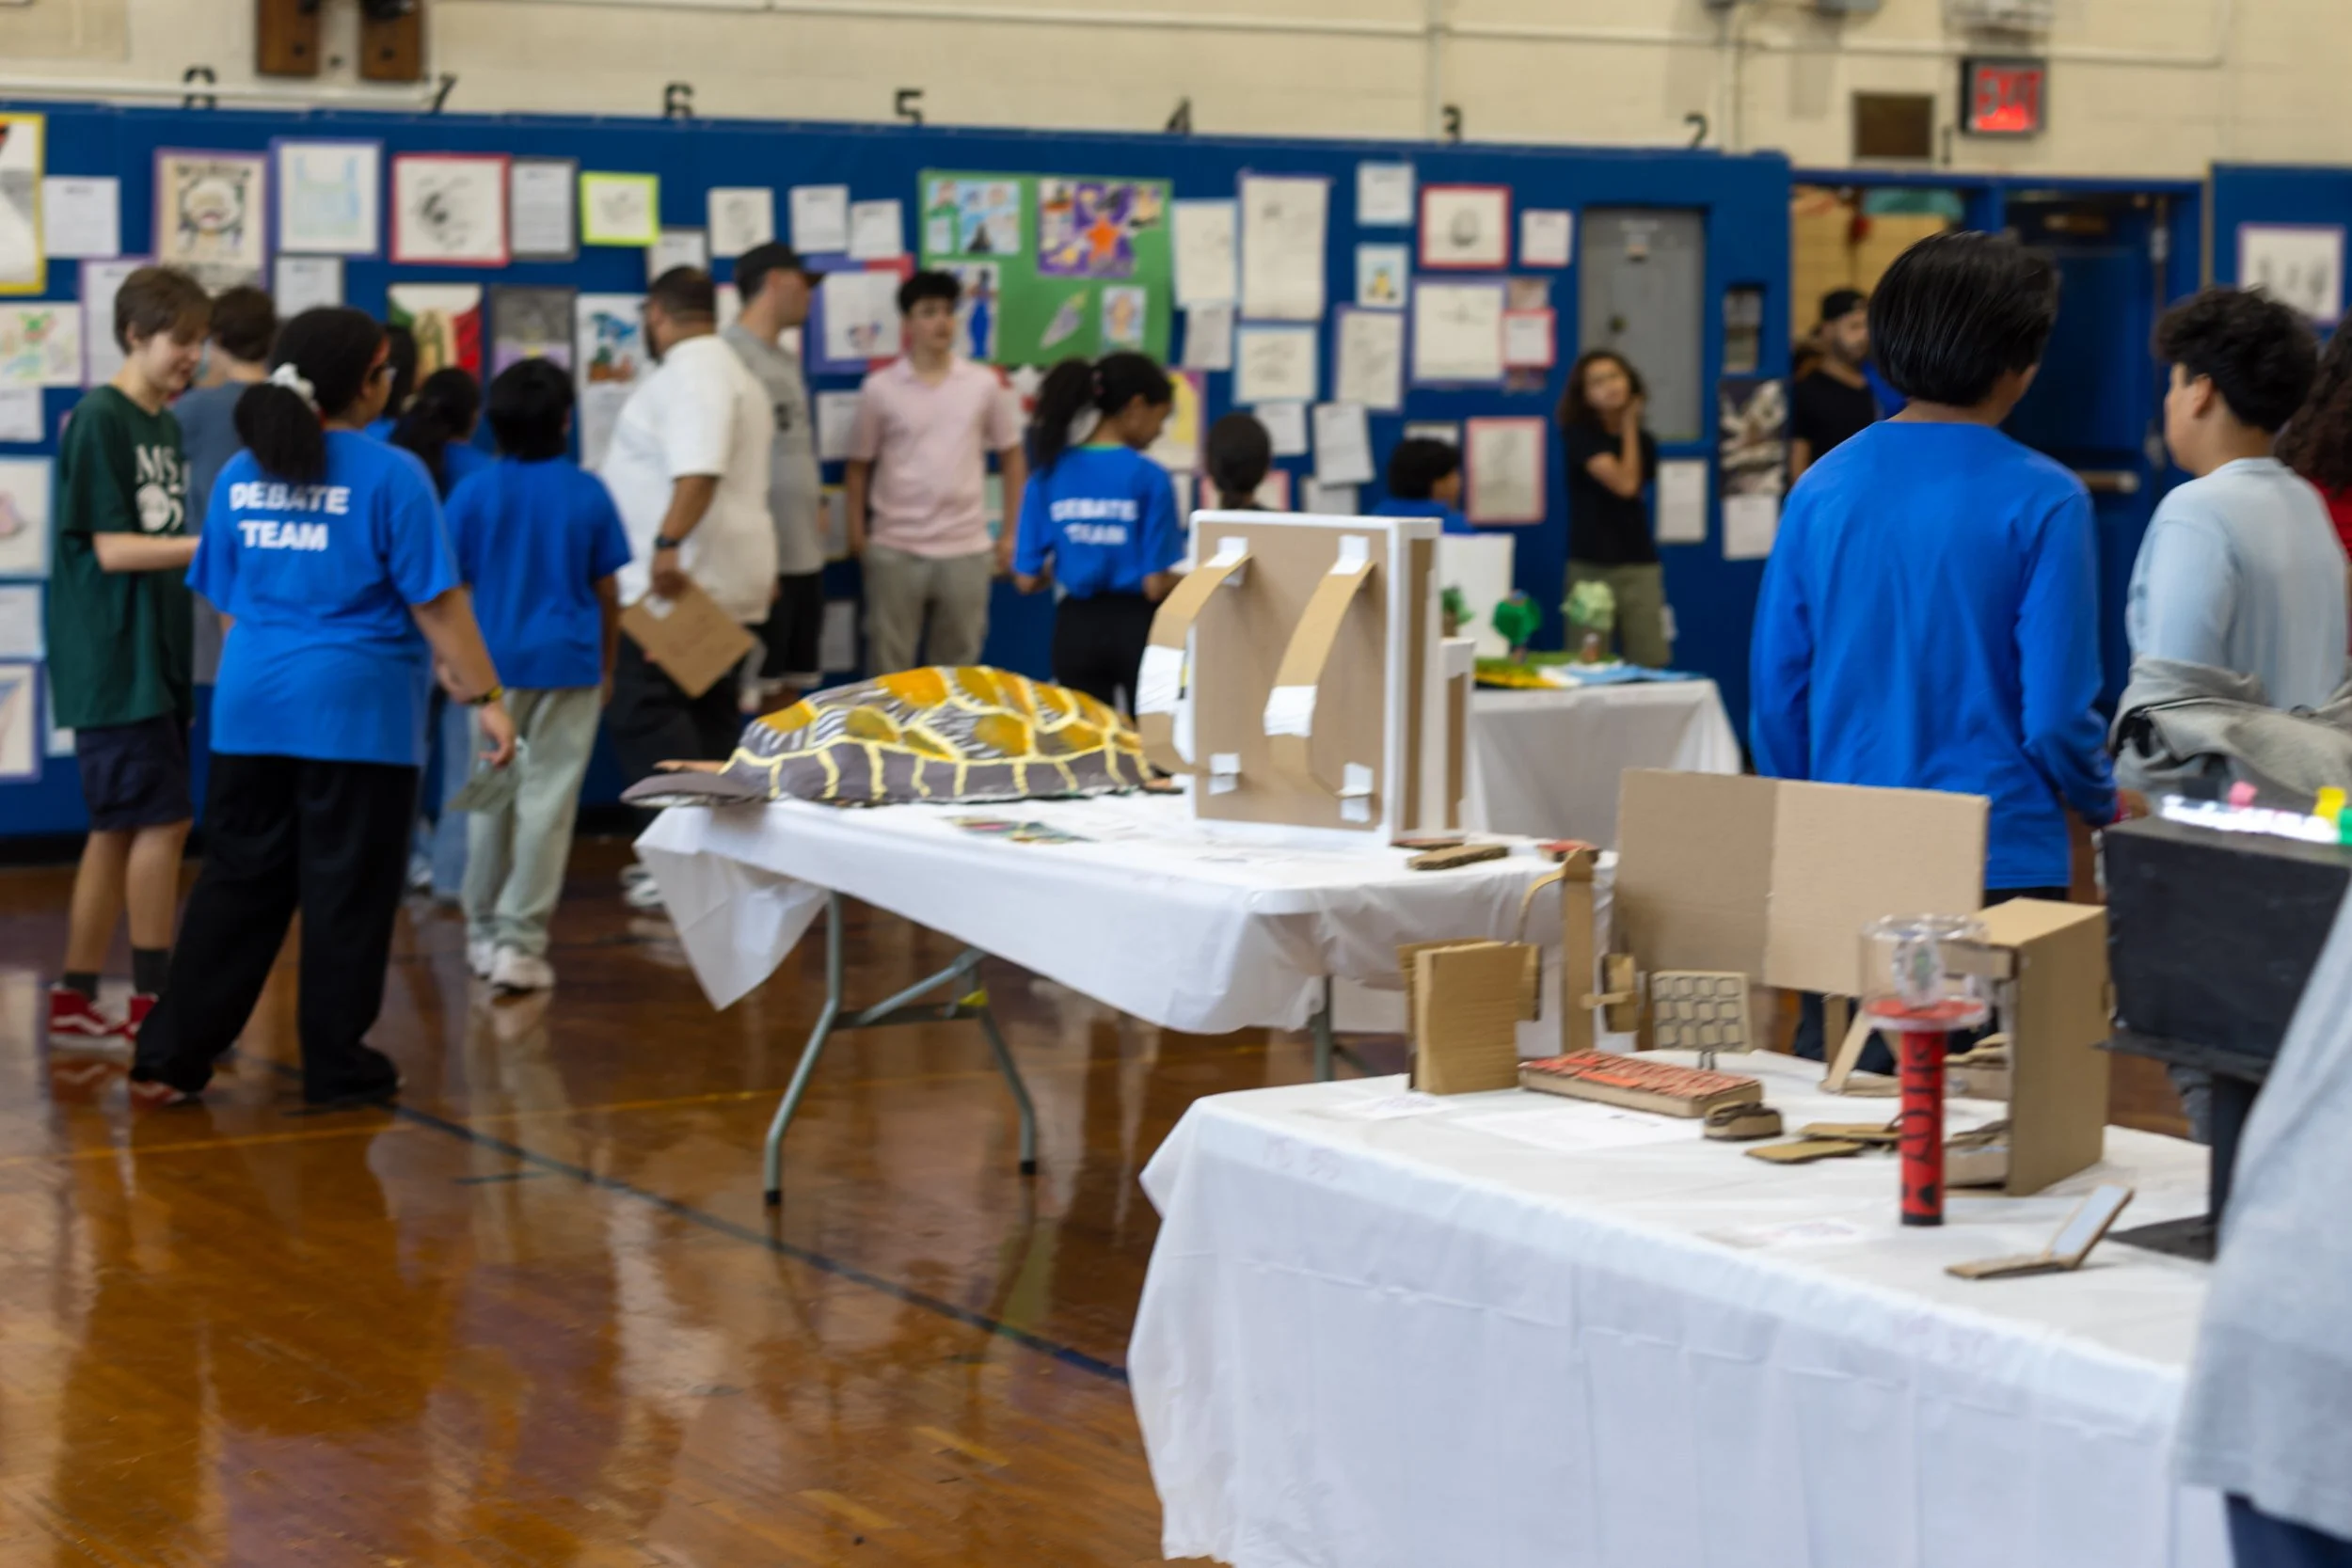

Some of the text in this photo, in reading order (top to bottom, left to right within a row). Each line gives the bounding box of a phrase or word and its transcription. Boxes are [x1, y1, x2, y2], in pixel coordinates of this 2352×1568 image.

[229, 482, 351, 515] DEBATE
[1050, 498, 1138, 522] DEBATE
[237, 519, 328, 551] TEAM
[1063, 523, 1128, 546] TEAM
